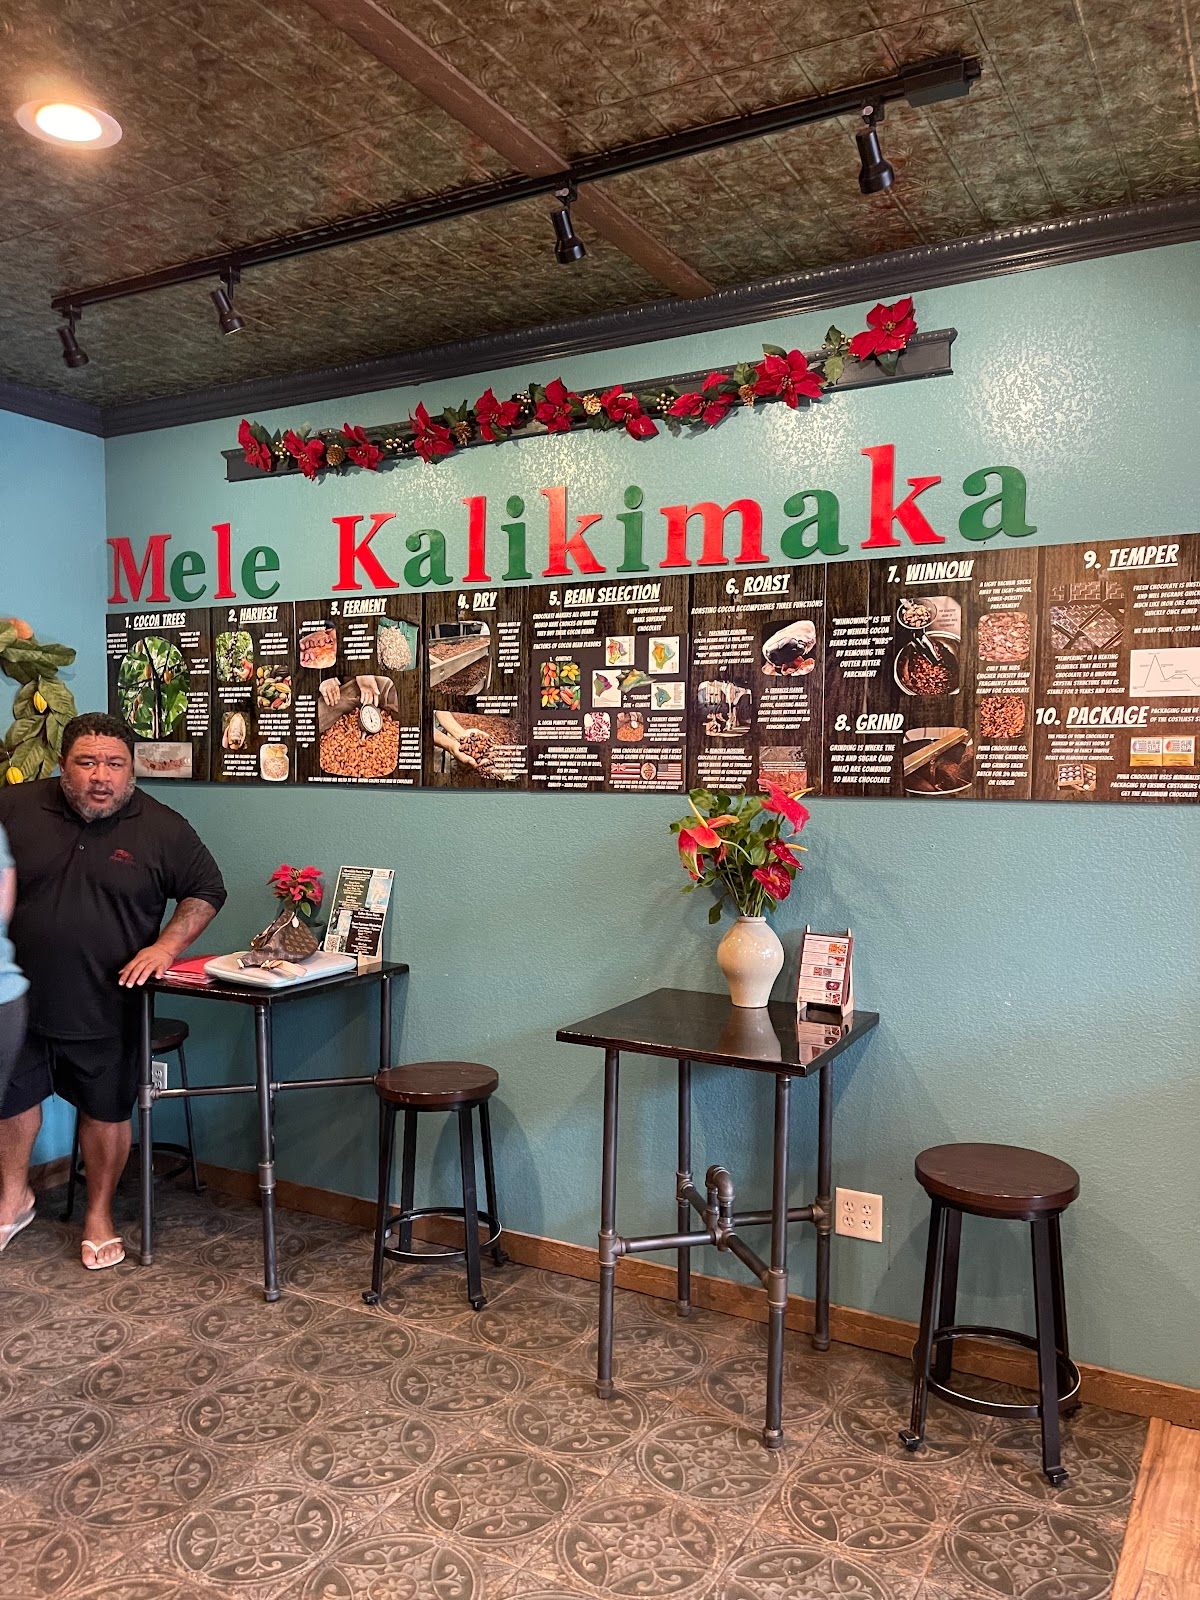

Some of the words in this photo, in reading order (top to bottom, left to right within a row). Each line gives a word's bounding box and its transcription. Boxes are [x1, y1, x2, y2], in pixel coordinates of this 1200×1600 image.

[107, 523, 280, 603] Mele
[331, 443, 1037, 592] Kalikimaka
[1084, 550, 1102, 569] 9.
[1109, 544, 1179, 567] TEMPER
[887, 566, 901, 583] 7.
[906, 560, 974, 581] WINNOW
[726, 578, 739, 594] 6.
[744, 574, 791, 592] ROAST
[457, 593, 469, 609] 4.
[473, 591, 497, 608] DRY
[549, 590, 561, 606] 5.
[564, 587, 595, 604] BEAN
[597, 583, 661, 602] SELECTION
[228, 609, 237, 622] 2.
[240, 606, 278, 621] HARVEST
[330, 602, 340, 616] 3.
[343, 598, 387, 614] FERMENT
[125, 617, 131, 628] 1.
[134, 614, 160, 627] COCOA
[162, 613, 186, 625] TREES
[834, 714, 851, 731] 8.
[856, 713, 904, 730] GRIND
[1035, 707, 1061, 725] 10.
[1066, 706, 1149, 724] PACKAGE
